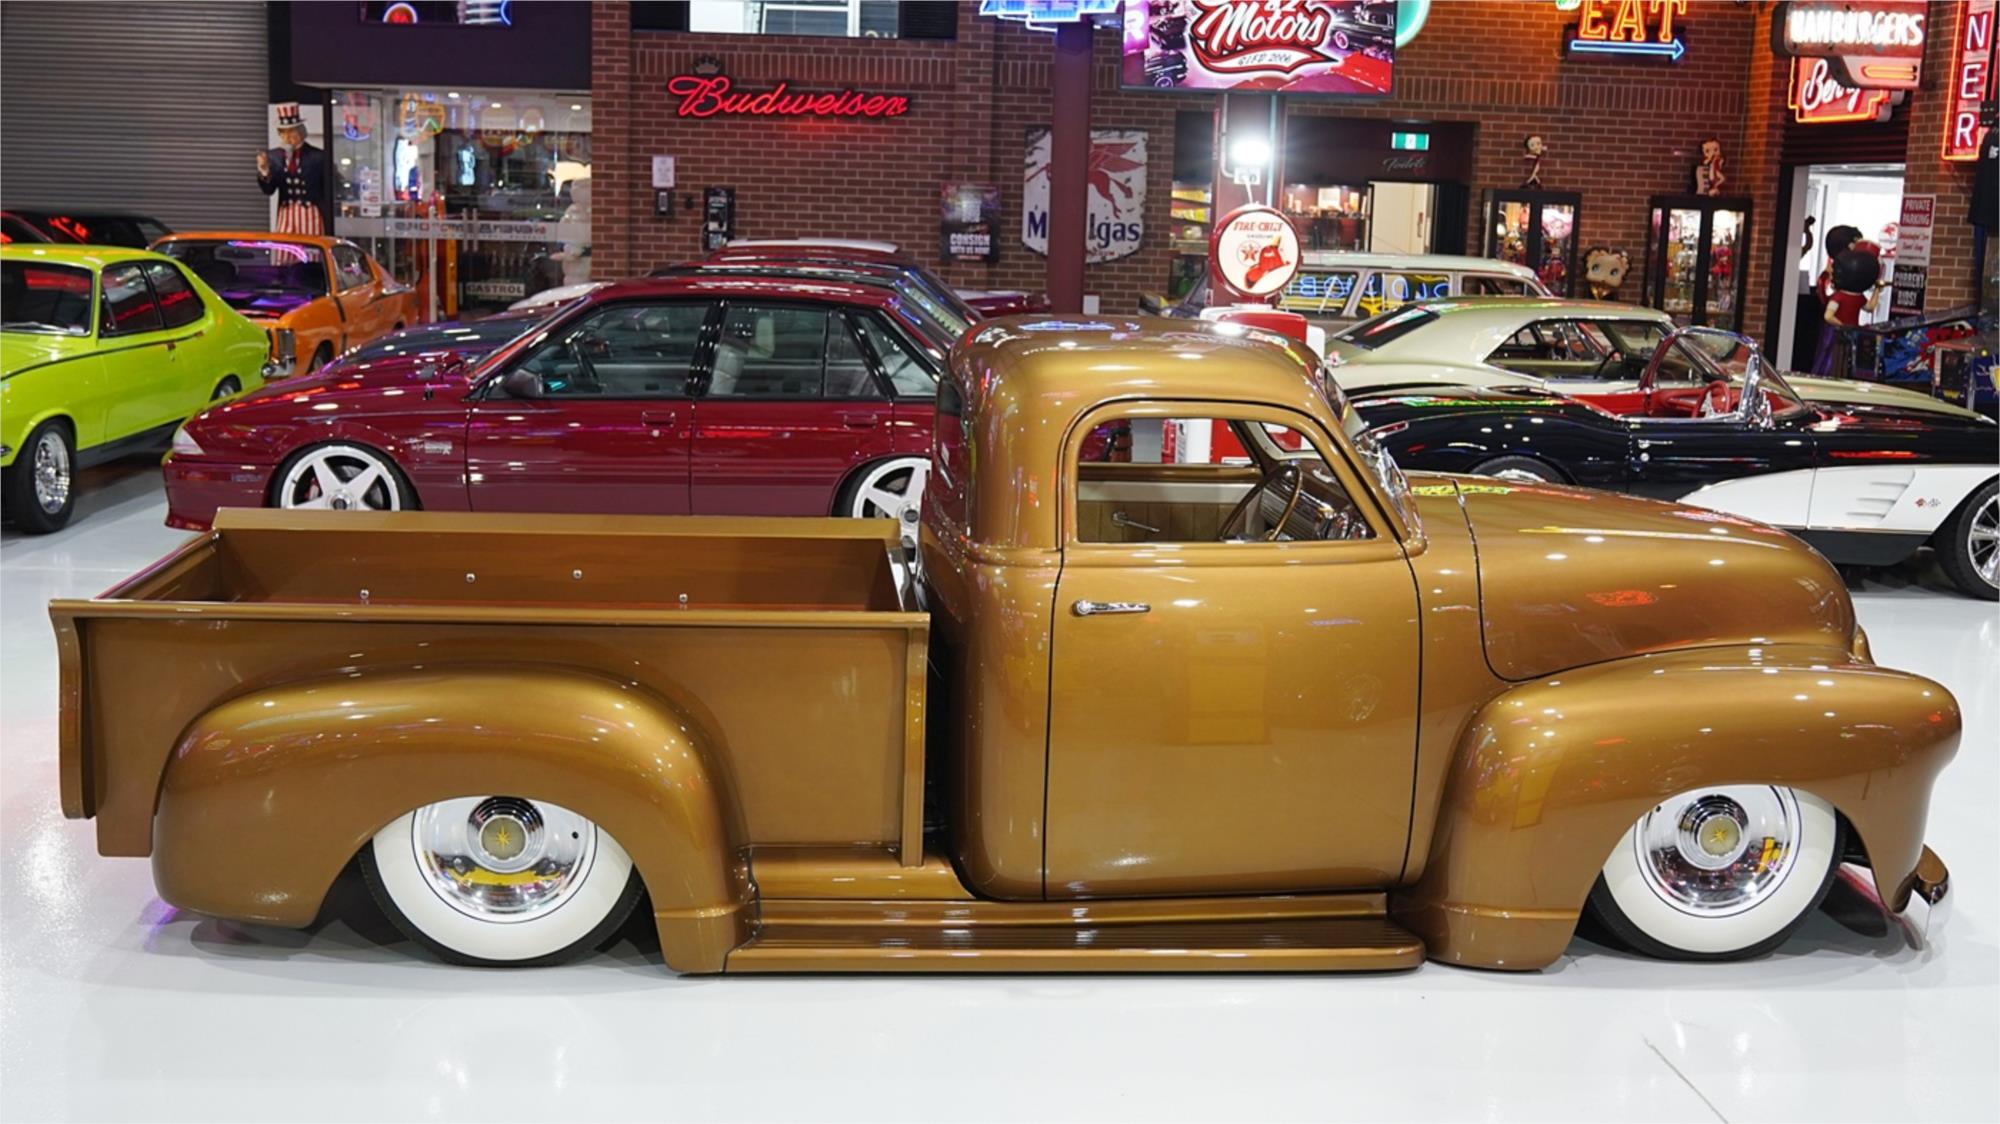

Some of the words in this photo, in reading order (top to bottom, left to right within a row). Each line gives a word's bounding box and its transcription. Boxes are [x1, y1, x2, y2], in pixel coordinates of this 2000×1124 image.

[1197, 2, 1325, 51] Motors
[1579, 0, 1686, 42] EAT
[1791, 9, 1924, 46] HAMBURGERS
[668, 76, 908, 117] Budweiser
[1904, 199, 1931, 212] PRIVATE
[1902, 212, 1930, 226] PARKING
[950, 233, 990, 246] CONSIGN
[467, 283, 524, 295] CASTROL
[1894, 271, 1925, 289] CURRENT
